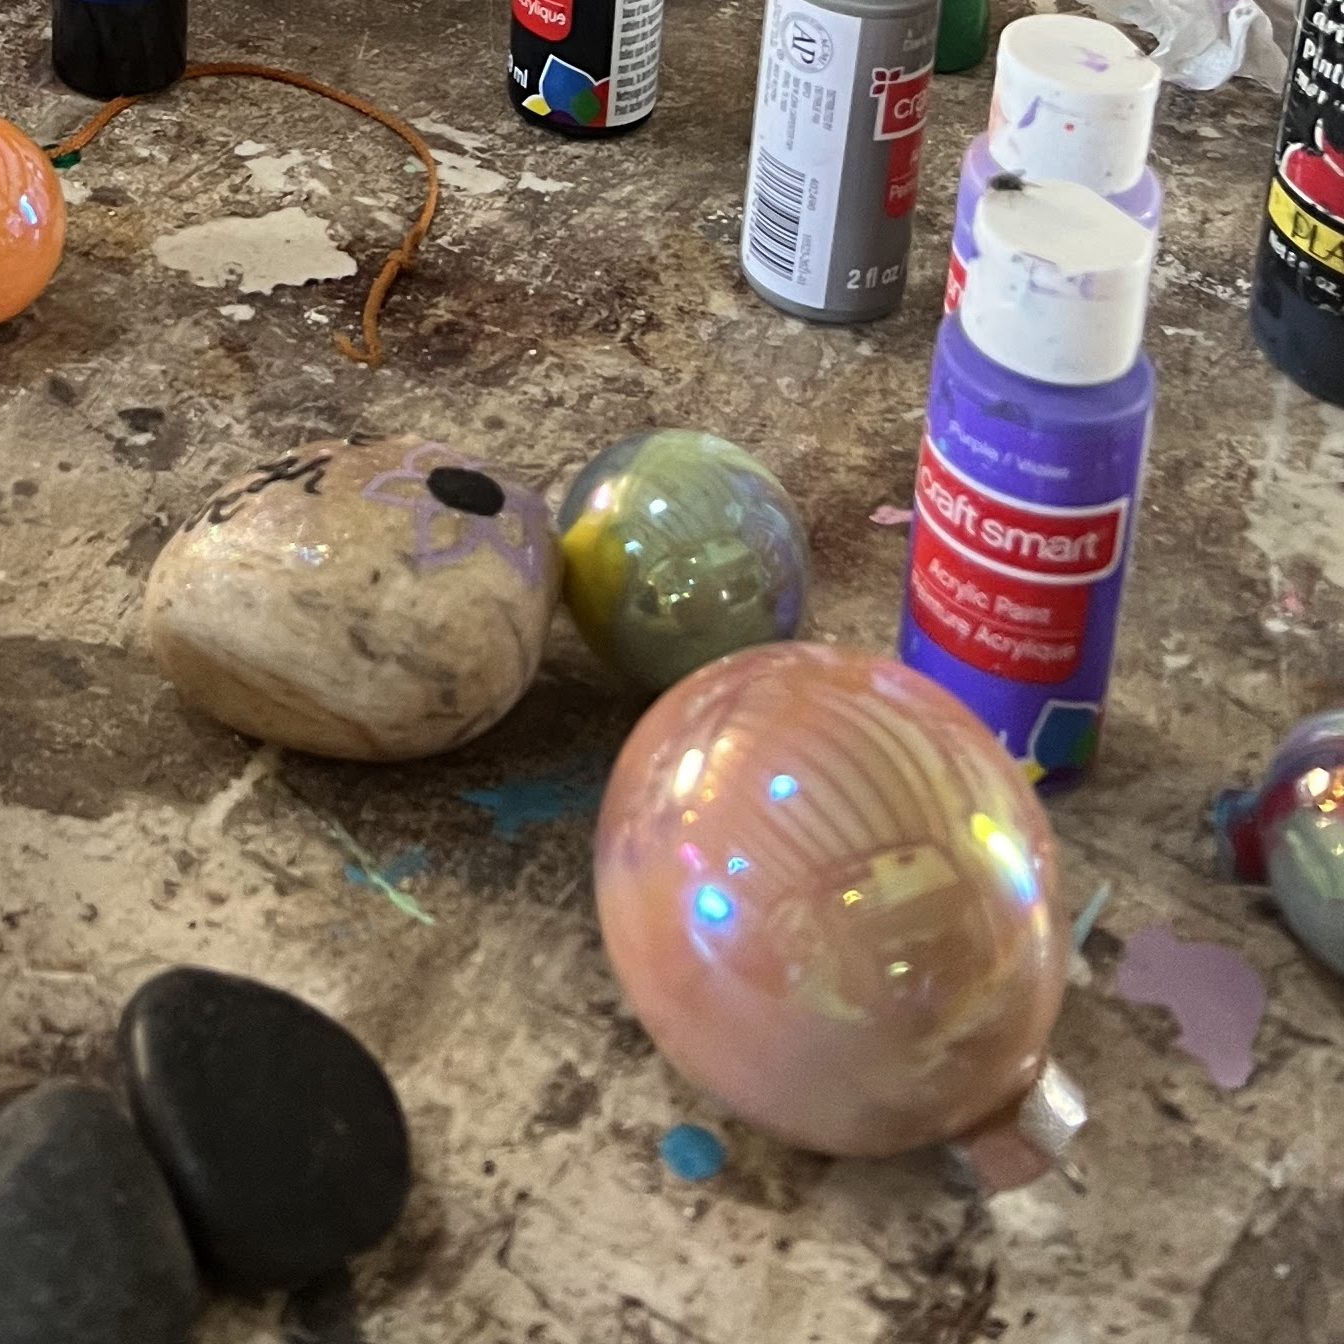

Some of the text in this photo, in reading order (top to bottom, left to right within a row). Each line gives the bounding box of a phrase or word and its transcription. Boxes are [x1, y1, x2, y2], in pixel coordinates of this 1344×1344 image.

[792, 20, 817, 65] AP
[846, 264, 901, 290] 2 fl oz
[920, 465, 1101, 564] craft smart
[927, 557, 1053, 626] Acrylic Paint
[974, 624, 1078, 663] Acrylique
